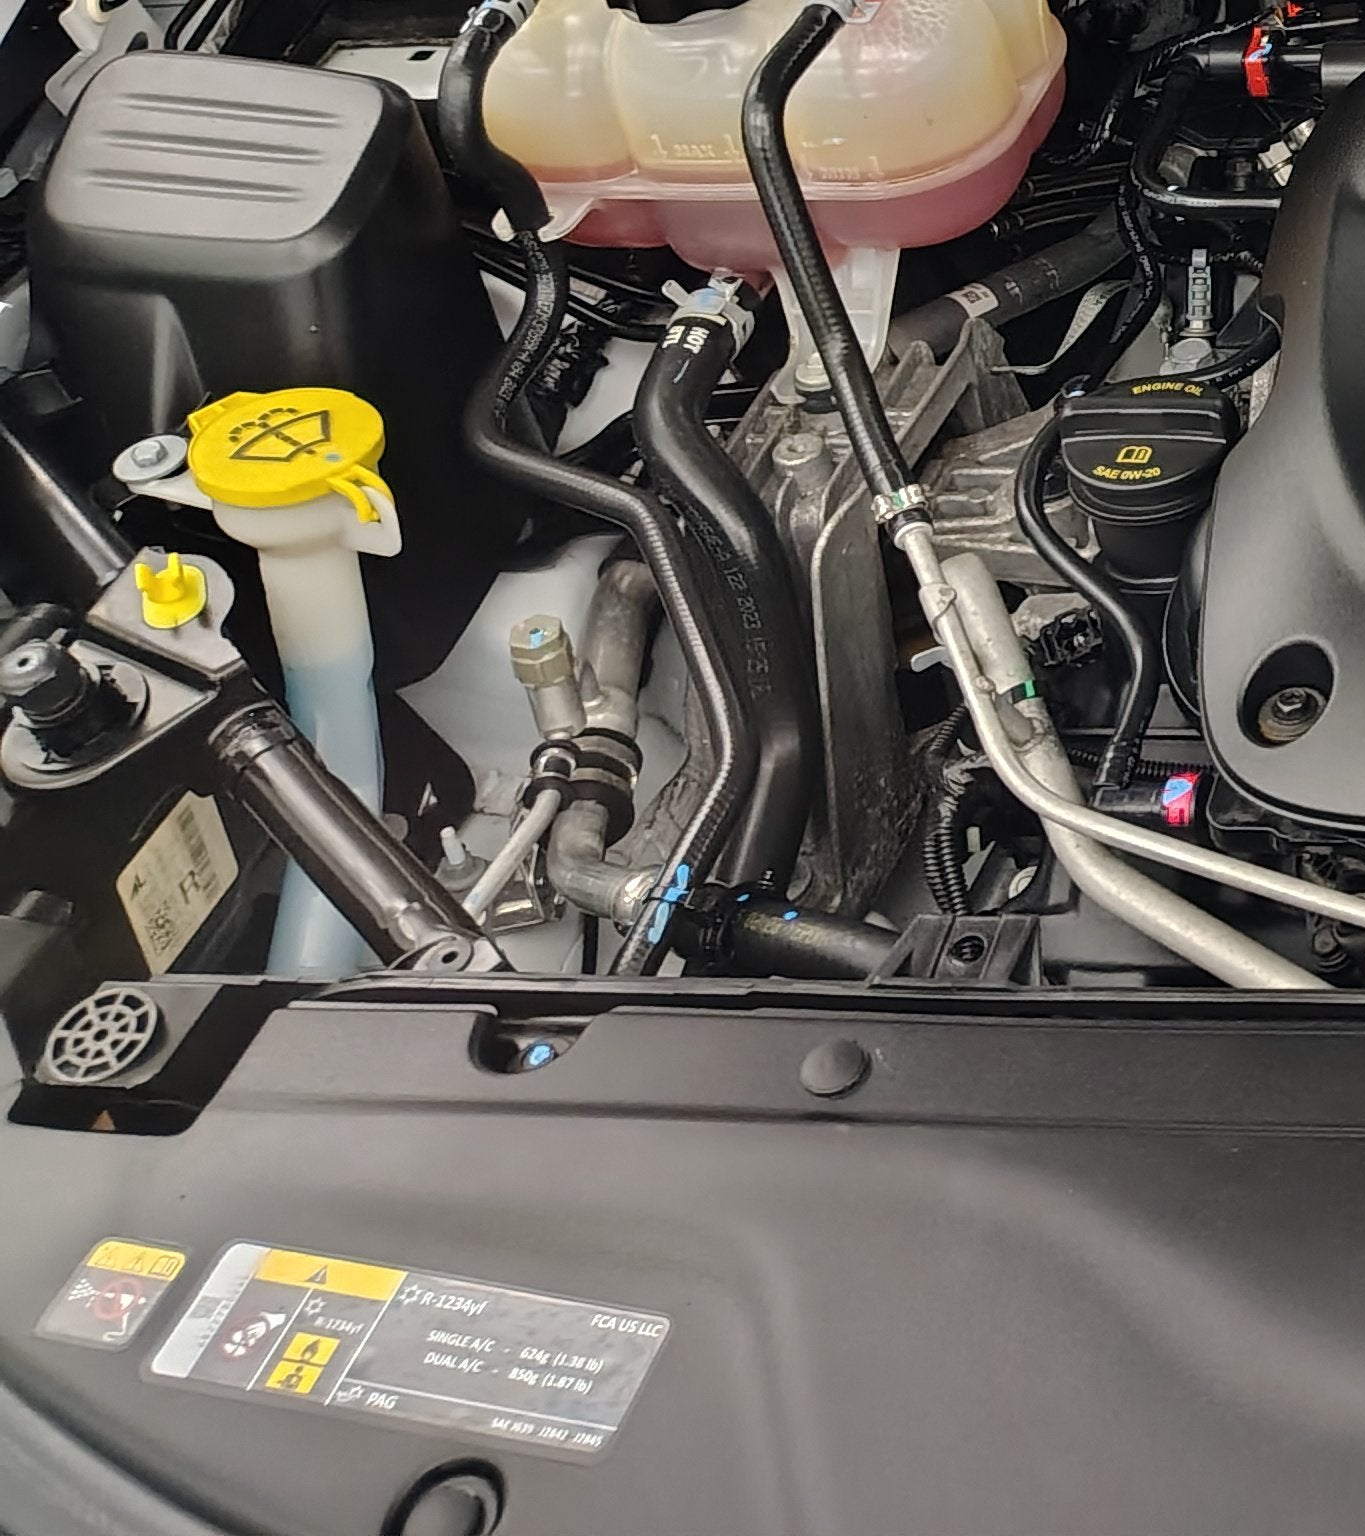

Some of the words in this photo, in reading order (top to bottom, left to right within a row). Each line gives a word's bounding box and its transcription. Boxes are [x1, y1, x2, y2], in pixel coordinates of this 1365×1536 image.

[683, 326, 710, 355] HOT
[1131, 381, 1184, 395] ENGINE
[1184, 382, 1206, 397] OIL
[1092, 465, 1118, 480] SAE
[1120, 467, 1161, 481] 0W-20
[420, 1291, 487, 1317] R-1234yf
[590, 1314, 617, 1330] FCA
[618, 1317, 637, 1333] US
[637, 1322, 664, 1338] LLC
[426, 1329, 471, 1349] SINGLE
[469, 1338, 495, 1355] A/C
[520, 1347, 551, 1365] 624g
[584, 1356, 605, 1375] lb)
[424, 1351, 457, 1367] DUAL
[456, 1356, 482, 1374] A/C
[508, 1368, 538, 1386] 850g
[541, 1373, 573, 1391] (1.87
[572, 1378, 593, 1396] lb)
[366, 1392, 400, 1410] PAG
[491, 1417, 510, 1430] SAE
